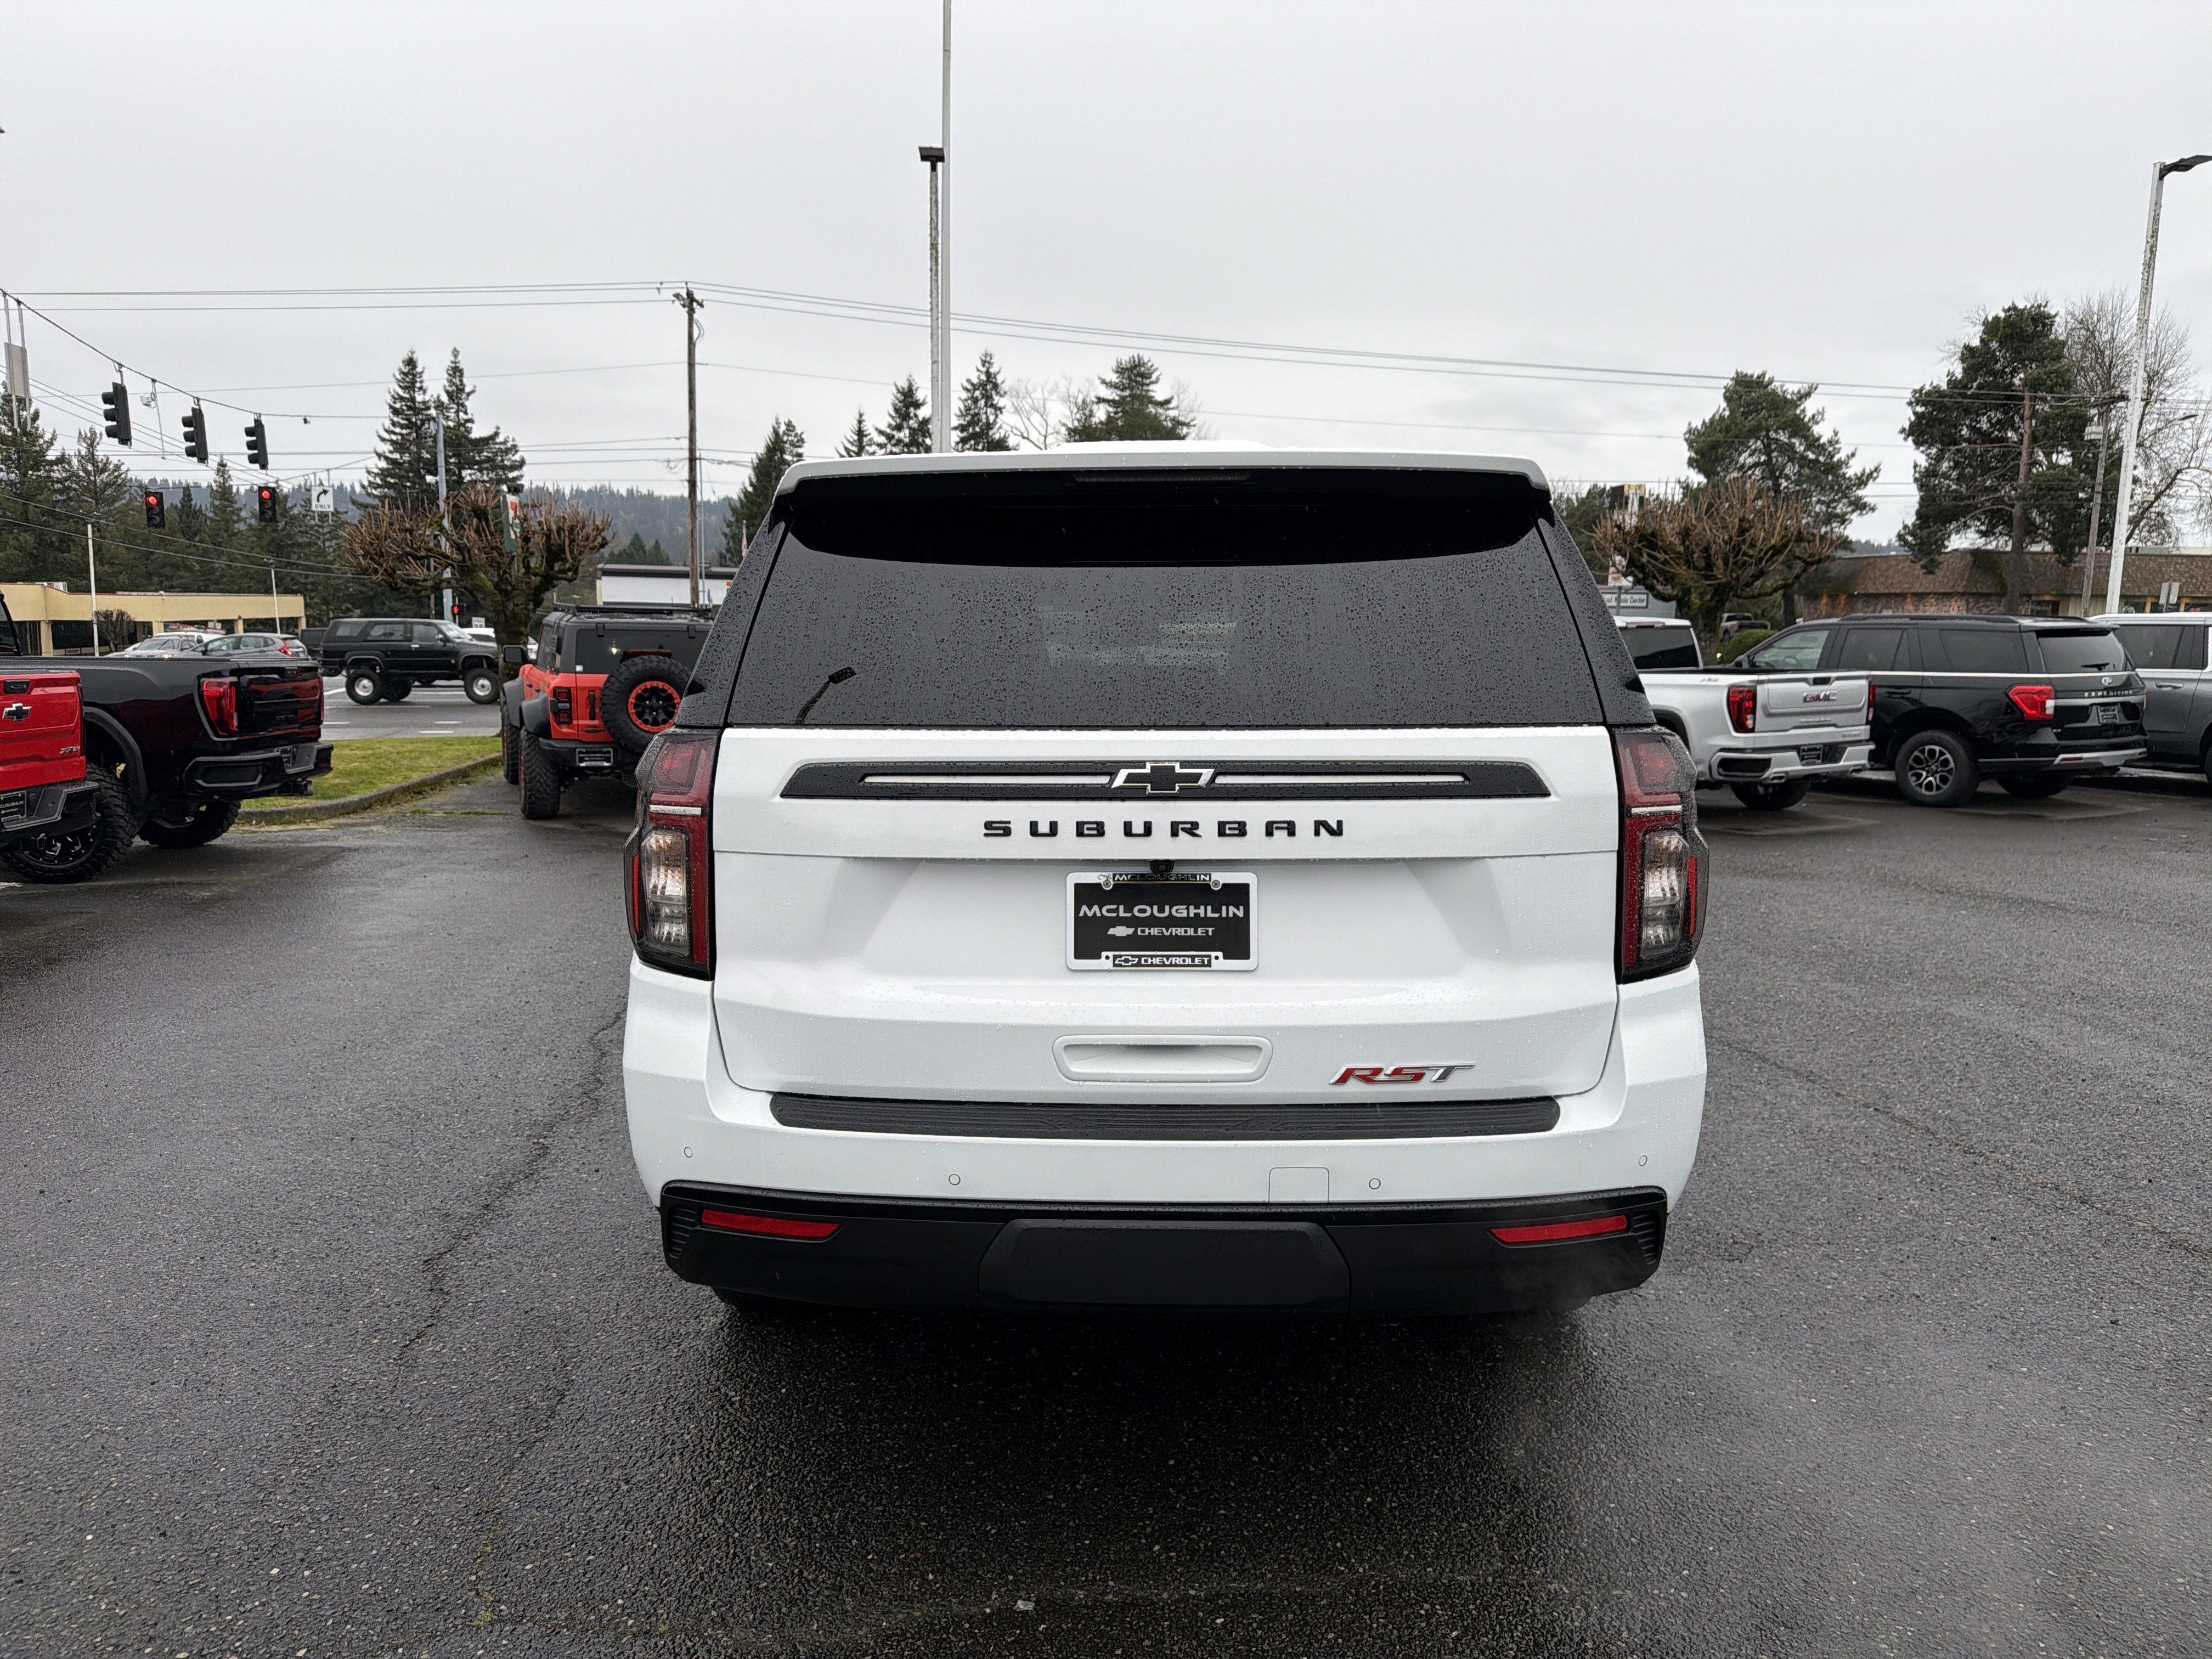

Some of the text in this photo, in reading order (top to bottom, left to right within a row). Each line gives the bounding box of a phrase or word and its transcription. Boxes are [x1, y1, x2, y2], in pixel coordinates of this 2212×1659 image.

[1803, 691, 1837, 702] GMC
[983, 820, 1344, 838] SUBURBAN
[1114, 873, 1210, 881] MCLOUGHLIN
[1079, 904, 1244, 917] MCLOUGHLIN
[1137, 927, 1215, 936] CHEVROLET
[1141, 957, 1210, 965] CHEVROLET
[1328, 1063, 1476, 1085] RST
